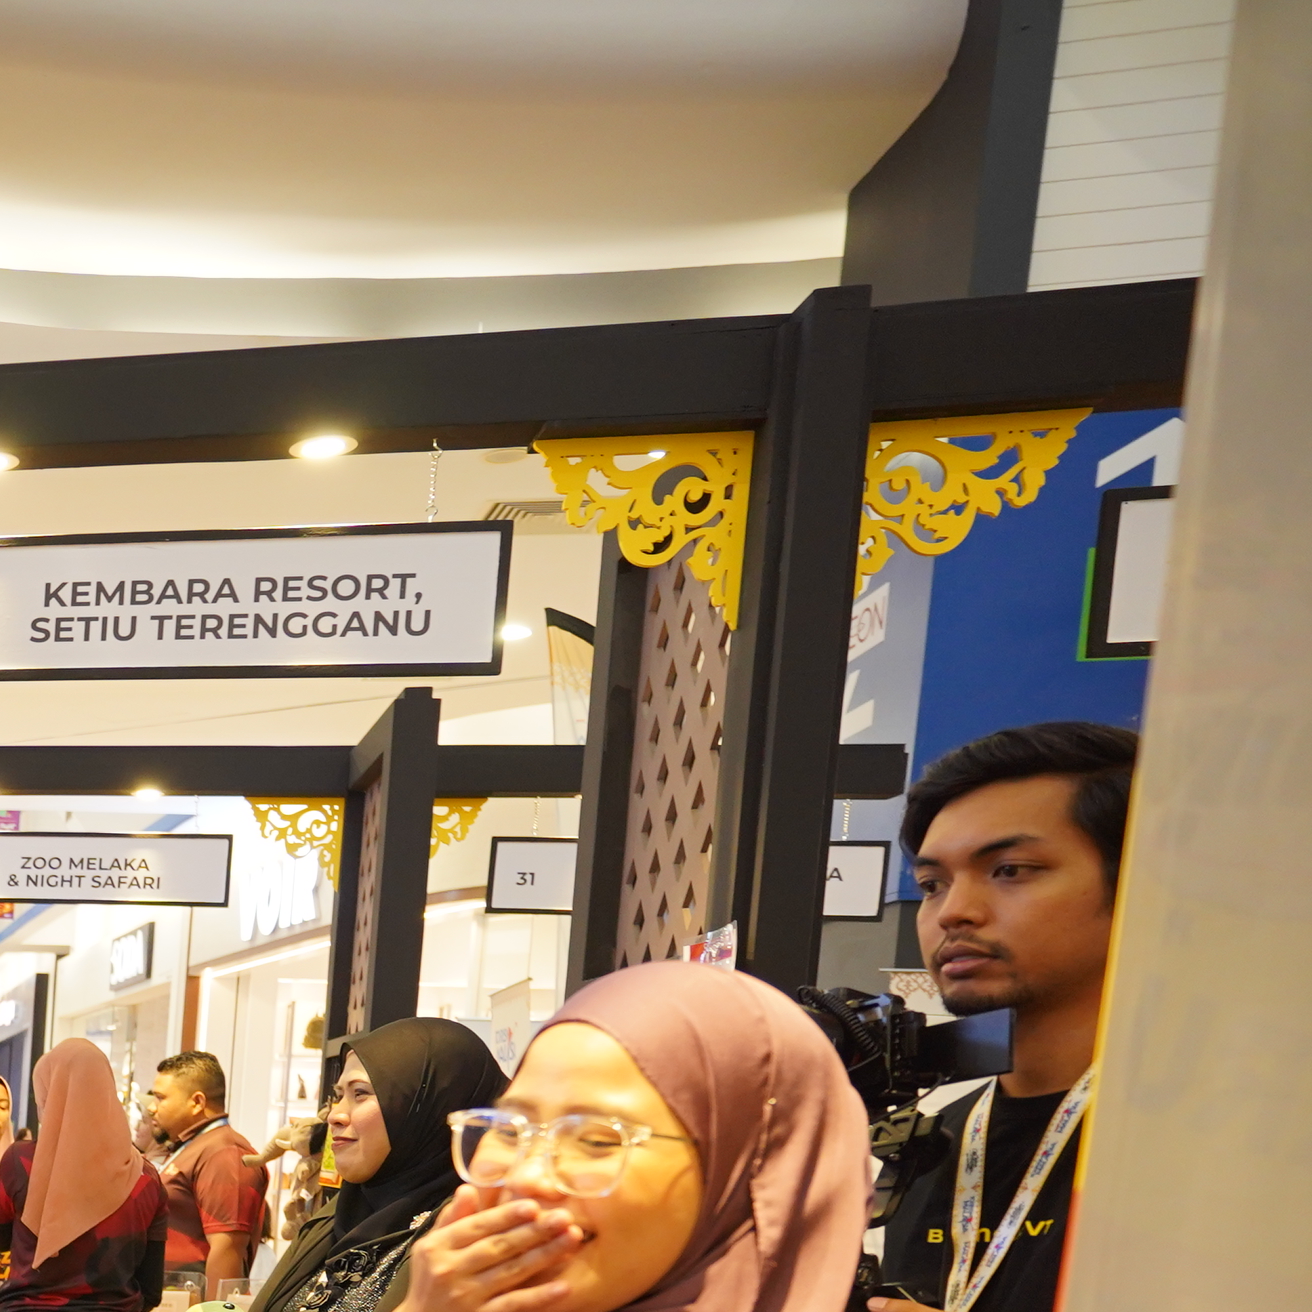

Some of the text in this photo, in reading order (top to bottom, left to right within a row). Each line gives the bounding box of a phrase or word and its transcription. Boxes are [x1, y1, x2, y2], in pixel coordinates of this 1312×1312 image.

[42, 572, 424, 610] KEMBARA RESORT,
[29, 608, 433, 644] SETIU TERENGGANU
[20, 855, 151, 873] ZOO MELAKA
[7, 873, 161, 891] & NIGHT SAFARI
[515, 871, 536, 886] 31
